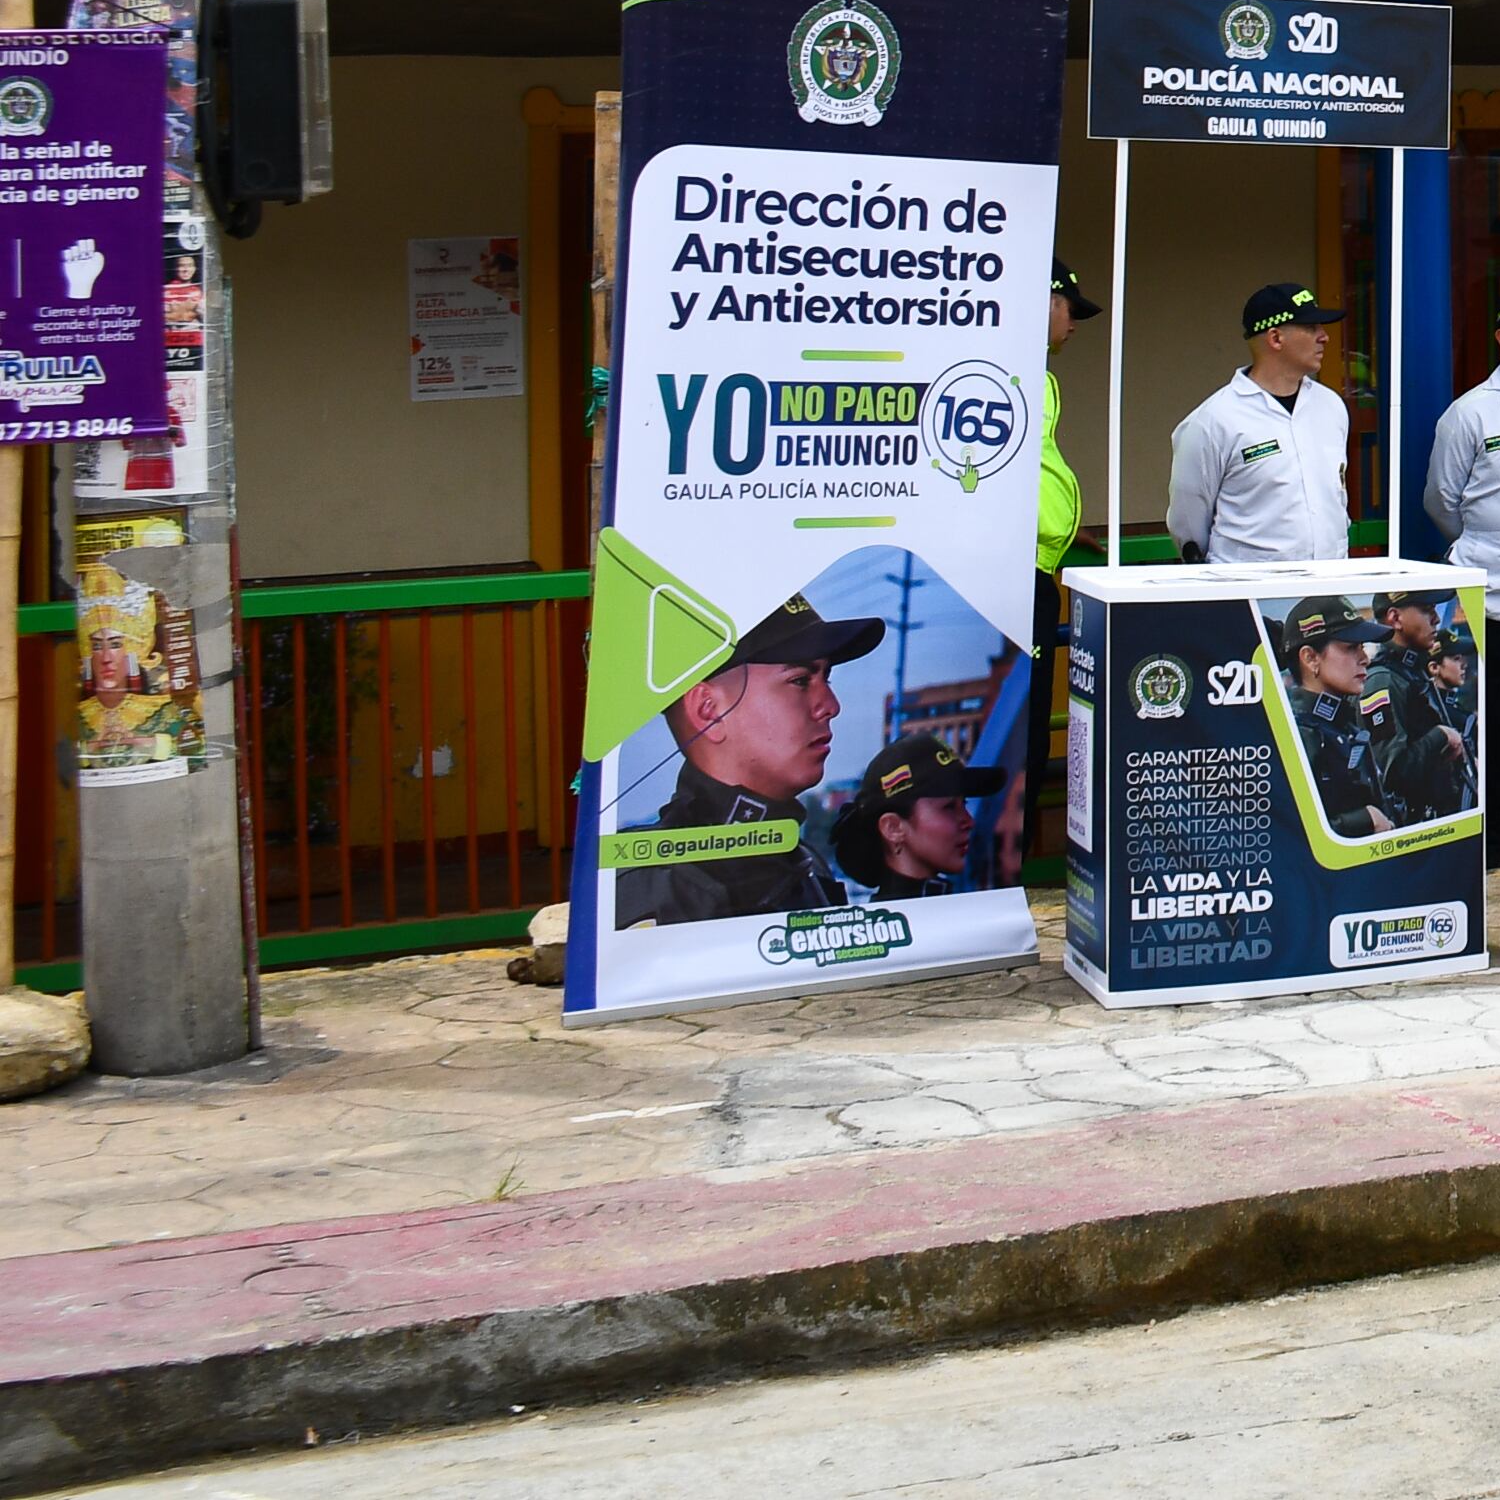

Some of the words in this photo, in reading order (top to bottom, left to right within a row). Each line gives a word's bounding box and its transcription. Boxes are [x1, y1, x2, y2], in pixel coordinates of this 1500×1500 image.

[842, 12, 856, 21] DE
[1287, 11, 1340, 54] S2D
[1143, 63, 1257, 96] POLICÍA
[1262, 71, 1404, 100] NACIONAL
[1142, 93, 1205, 107] DIRECCIÓN
[1206, 96, 1223, 108] DE
[1223, 97, 1312, 112] ANTISECUESTRO
[1312, 101, 1321, 111] Y
[1321, 100, 1405, 114] ANTIEXTORSIÓN
[1207, 116, 1258, 137] GAULA
[1262, 117, 1327, 139] QUINDÍO
[23, 141, 81, 160] señal
[84, 140, 113, 157] de
[38, 161, 147, 181] identificar
[32, 184, 60, 202] de
[64, 183, 140, 206] género
[674, 172, 929, 233] Dirección
[942, 188, 1008, 235] de
[671, 231, 1004, 283] Antisecuestro
[39, 306, 76, 318] Cierre
[78, 305, 90, 316] el
[93, 304, 126, 318] puño
[667, 294, 700, 330] y
[707, 284, 1001, 328] Antiextorsión
[33, 320, 84, 332] esconde
[88, 318, 99, 329] el
[101, 317, 142, 332] pulgar
[41, 332, 74, 344] entre
[76, 331, 95, 343] tus
[97, 330, 136, 342] dedos
[418, 357, 452, 370] 12%
[778, 385, 819, 423] NO
[833, 385, 918, 423] PAGO
[26, 420, 70, 438] 713
[72, 417, 134, 437] 8846
[656, 372, 768, 477] YO
[938, 395, 1014, 448] 165
[775, 434, 920, 467] DENUNCIO
[662, 482, 735, 501] GAULA
[739, 479, 812, 500] POLICÍA
[815, 480, 920, 499] NACIONAL
[1207, 660, 1264, 706] S2D
[1125, 744, 1272, 768] GARANTIZANDO
[1125, 761, 1272, 785] GARANTIZANDO
[1125, 779, 1272, 803] GARANTIZANDO
[1125, 796, 1272, 820] GARANTIZANDO
[1125, 814, 1272, 838] GARANTIZANDO
[1395, 826, 1456, 849] @gaulapolicia
[655, 830, 784, 858] @gaulapolicia
[1125, 832, 1272, 856] GARANTIZANDO
[1126, 849, 1272, 873] GARANTIZANDO
[1129, 874, 1158, 895] LA
[1161, 871, 1223, 893] VIDA
[1225, 870, 1239, 890] Y
[1244, 867, 1273, 887] LA
[1130, 889, 1274, 921] LIBERTAD
[789, 914, 823, 928] Unidos
[823, 912, 854, 925] contra
[854, 909, 865, 922] la
[1129, 924, 1158, 944] LA
[1161, 921, 1223, 942] VIDA
[1225, 919, 1239, 939] Y
[1244, 916, 1273, 936] LA
[1380, 921, 1395, 934] NO
[1397, 916, 1424, 931] PAGO
[1429, 918, 1454, 934] 165
[790, 915, 906, 953] extorsión
[1343, 919, 1380, 954] YO
[1380, 931, 1425, 948] DENUNCIO
[824, 951, 836, 962] el
[836, 944, 886, 961] secuestro
[1130, 937, 1273, 971] LIBERTAD
